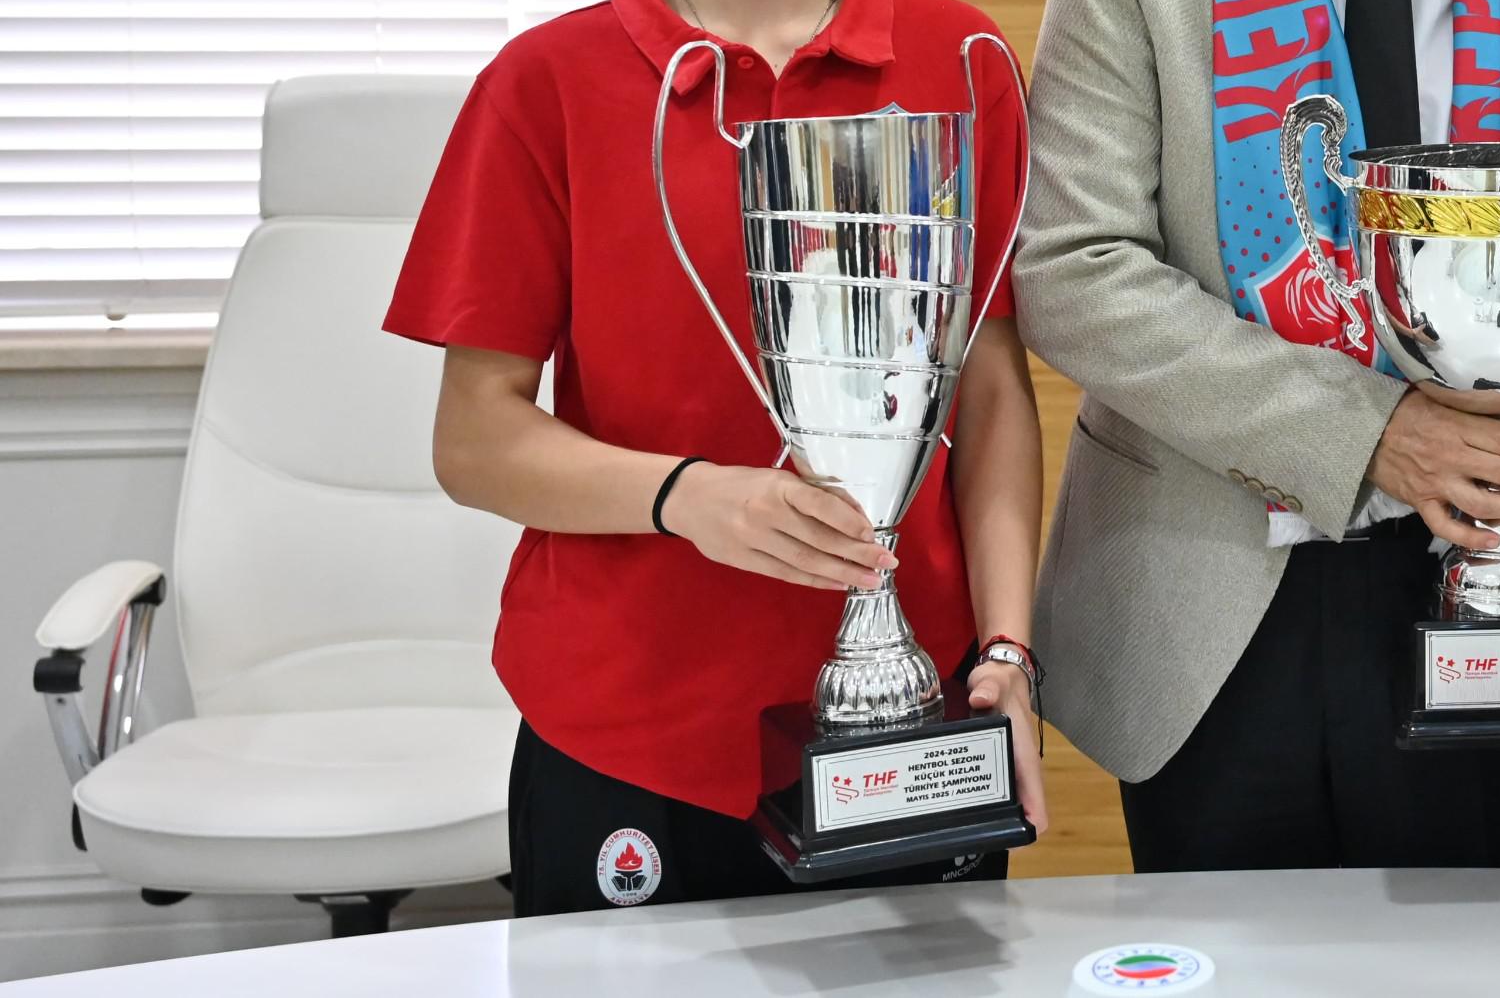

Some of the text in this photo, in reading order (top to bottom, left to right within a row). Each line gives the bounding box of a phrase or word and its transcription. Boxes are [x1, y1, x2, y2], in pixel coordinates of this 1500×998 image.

[1465, 658, 1498, 671] THF
[924, 745, 969, 759] 2024-2025
[908, 754, 986, 772] HENTBOL SEZONU
[863, 769, 898, 788] THF
[914, 765, 981, 782] KÜÇÜK KIZLAR
[904, 781, 939, 793] TÜRKİYE
[942, 773, 992, 789] ŞAMPİYONU
[906, 793, 929, 803] MAYIS
[931, 790, 950, 799] 2025
[956, 783, 991, 795] AKSARAY
